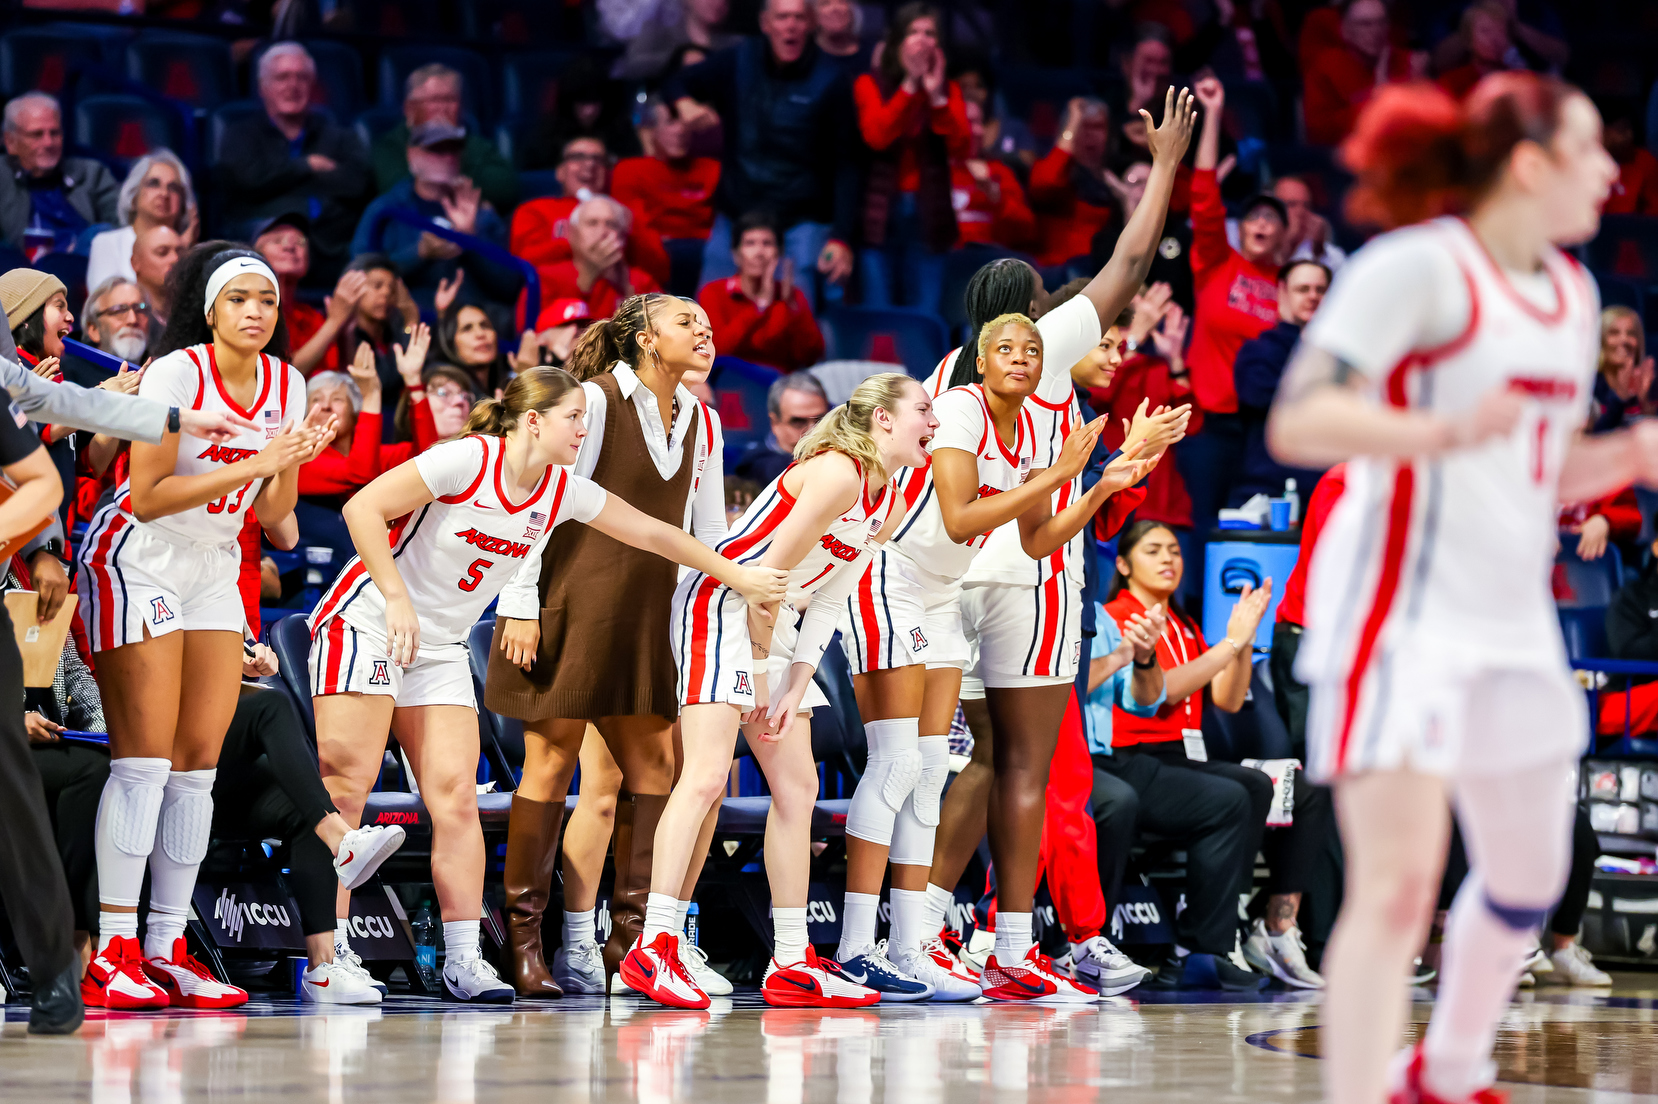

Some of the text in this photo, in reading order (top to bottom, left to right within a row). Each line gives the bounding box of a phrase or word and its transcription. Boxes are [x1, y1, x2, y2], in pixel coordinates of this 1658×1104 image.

[454, 527, 531, 559] ARIZONA
[458, 558, 494, 592] 5
[800, 563, 835, 589] 1
[150, 596, 175, 625] A
[909, 626, 929, 652] A
[369, 661, 390, 685] A
[733, 671, 753, 696] A
[374, 812, 419, 824] ARIZONA
